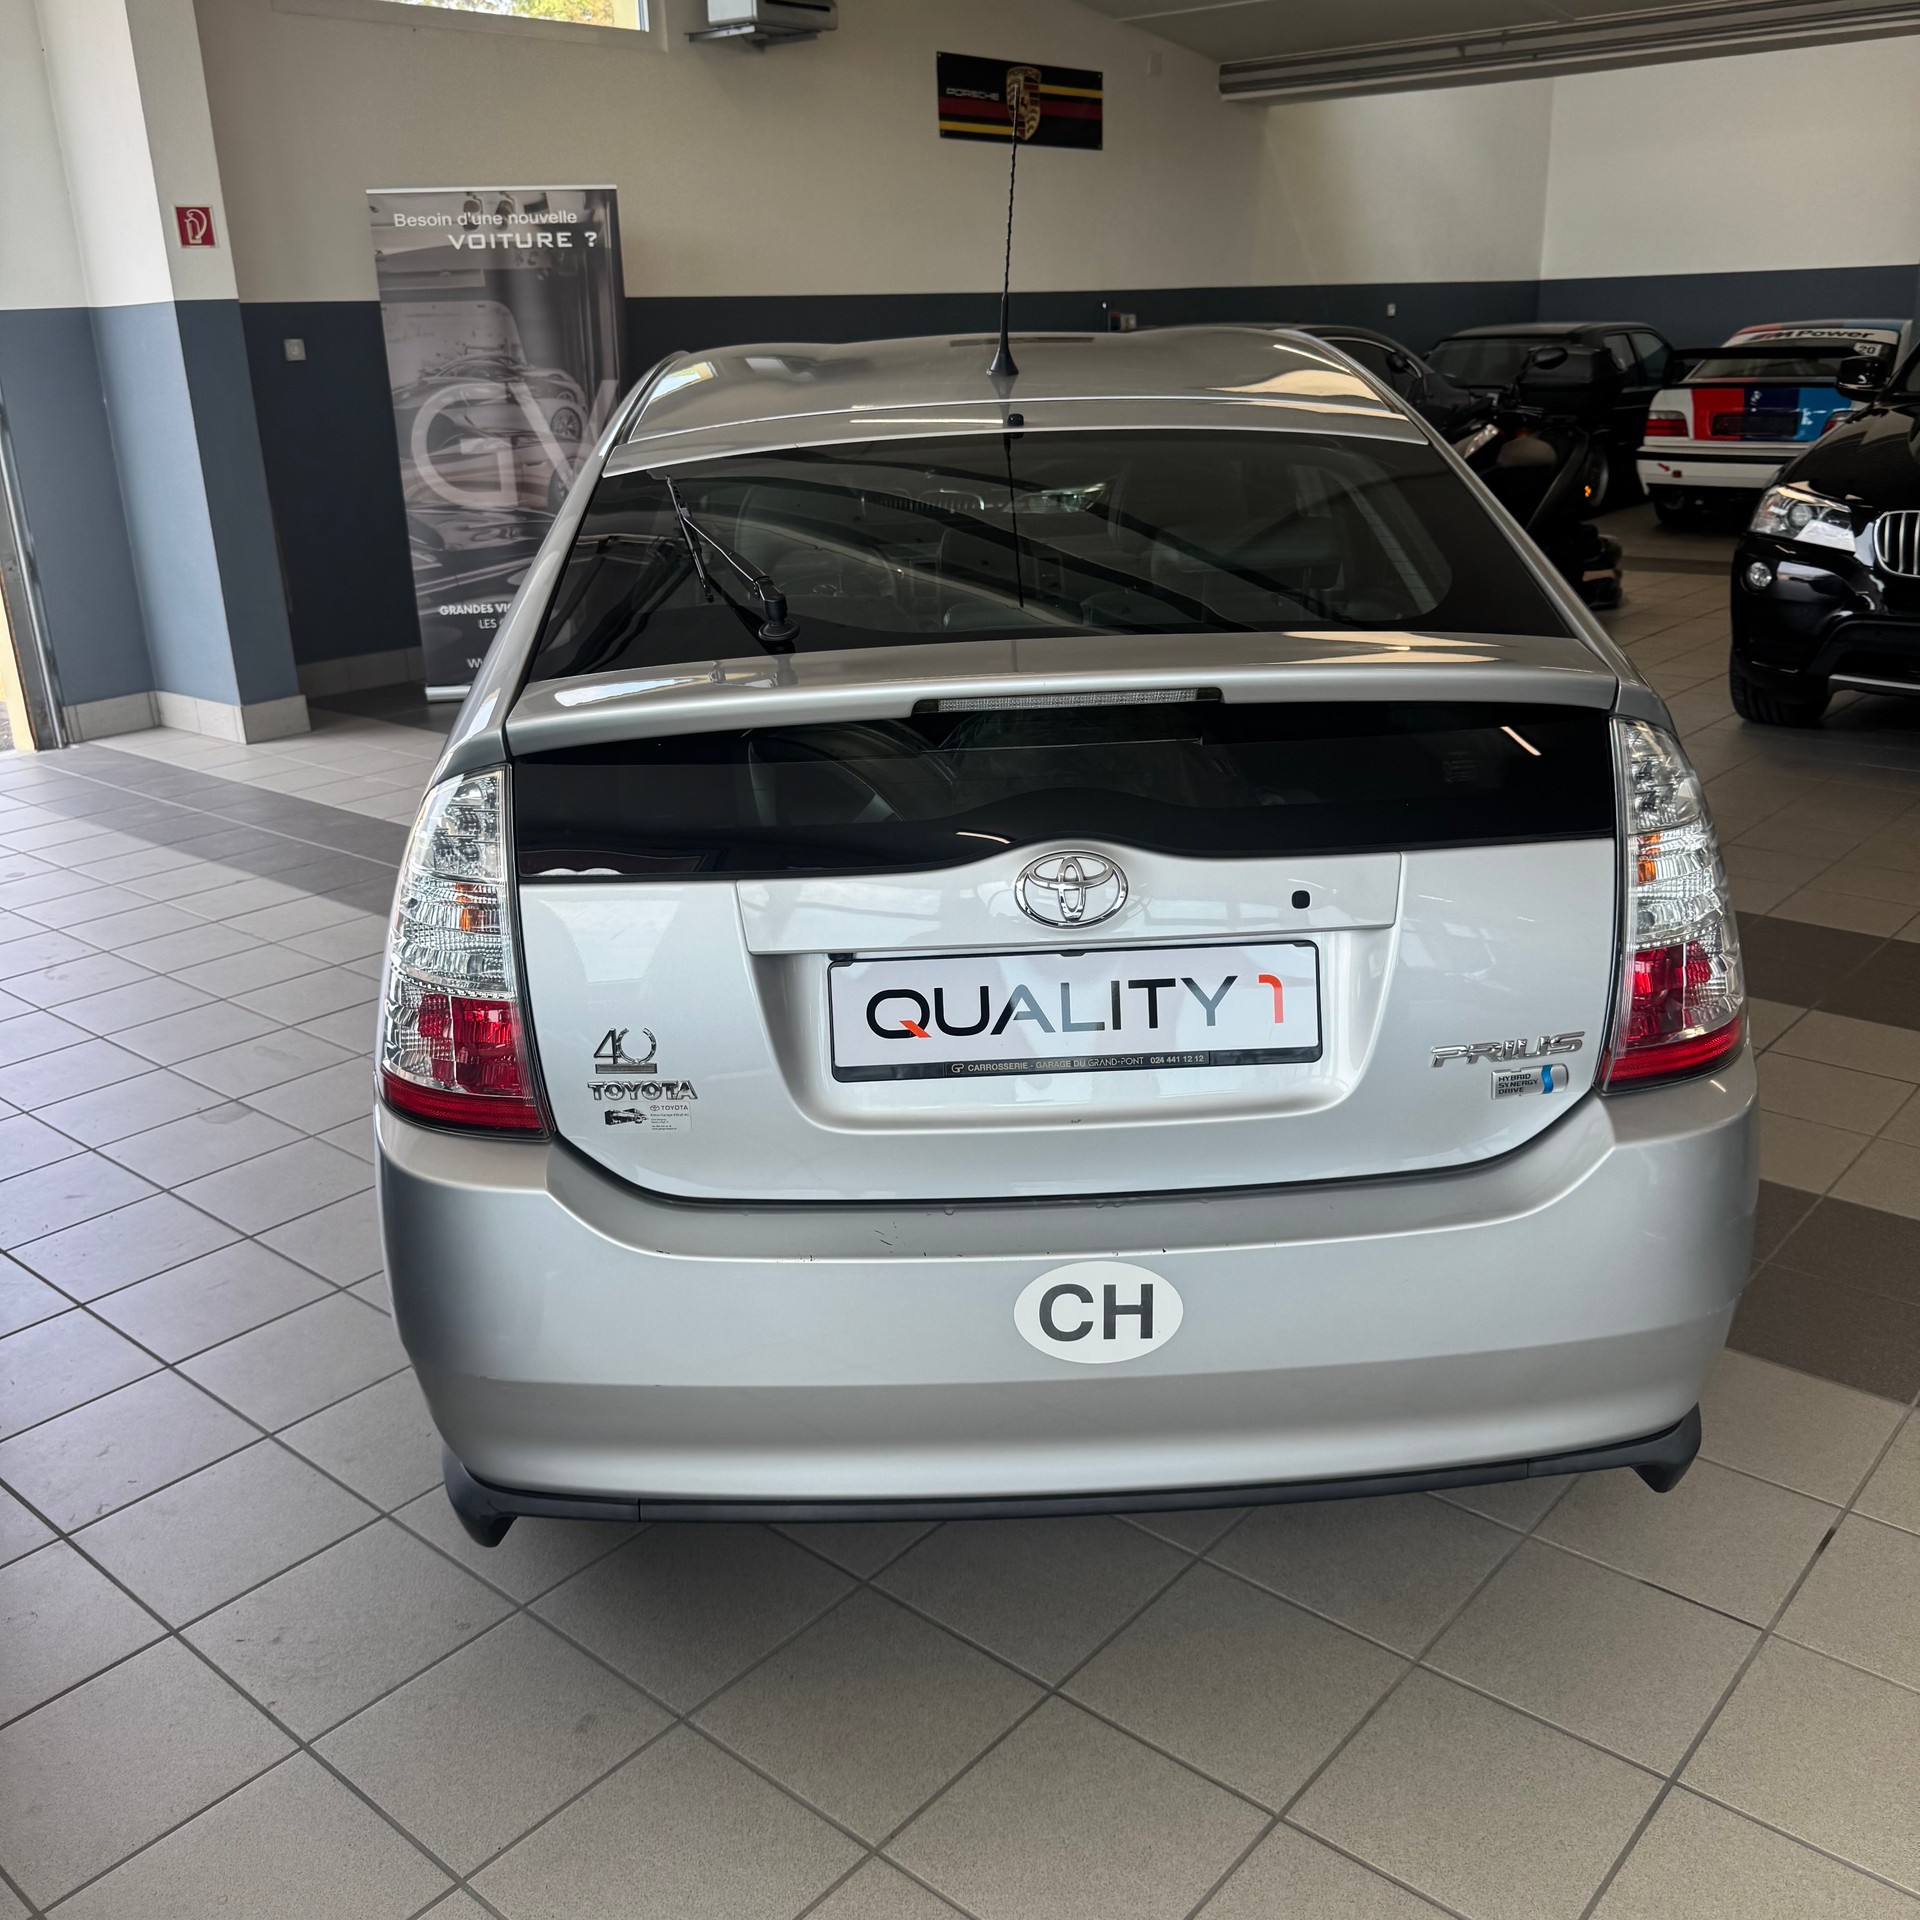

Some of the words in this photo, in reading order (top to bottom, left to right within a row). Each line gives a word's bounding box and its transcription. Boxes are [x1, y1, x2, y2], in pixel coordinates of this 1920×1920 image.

[946, 87, 1001, 101] PORSCHE
[394, 213, 452, 228] Besoin
[458, 212, 503, 226] d'une
[508, 210, 577, 225] nouvelle
[448, 231, 573, 250] VOITURE
[584, 231, 598, 248] ?
[1795, 329, 1875, 340] Power
[439, 603, 494, 616] GRANDES
[479, 618, 497, 629] LES
[866, 975, 1238, 1040] QUALITY
[1258, 973, 1284, 1024] 1
[1431, 1031, 1585, 1068] PRIUS
[967, 1061, 1029, 1073] CARROSSERIE
[1036, 1059, 1072, 1069] GARAGE
[1074, 1059, 1086, 1068] DU
[1088, 1056, 1145, 1067] GRAND-PONT
[1150, 1056, 1166, 1065] 024
[1166, 1056, 1182, 1064] 441
[1183, 1055, 1193, 1063] 12
[1194, 1055, 1204, 1063] 12
[1498, 1073, 1532, 1082] HYBRID
[1498, 1079, 1539, 1089] SYNERGY
[587, 1080, 698, 1101] TOYOTA
[1498, 1086, 1525, 1095] DRIVE
[1039, 1283, 1154, 1342] CH
